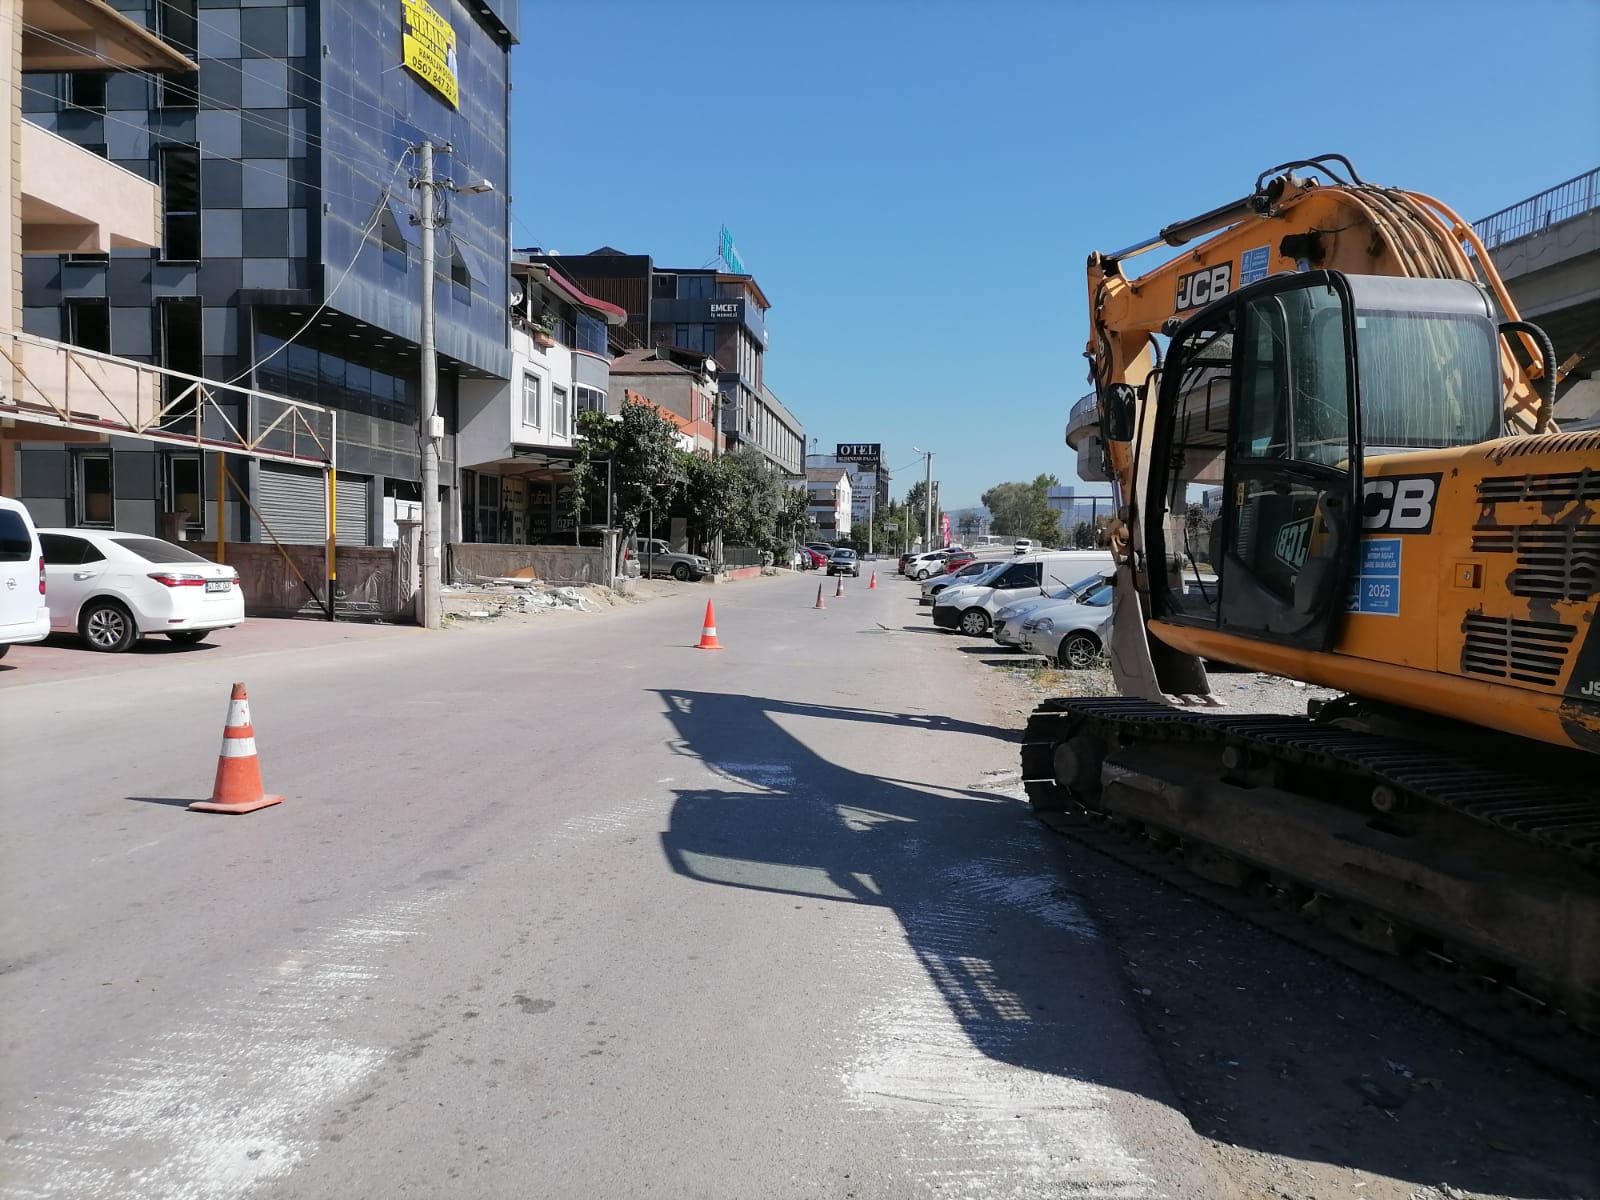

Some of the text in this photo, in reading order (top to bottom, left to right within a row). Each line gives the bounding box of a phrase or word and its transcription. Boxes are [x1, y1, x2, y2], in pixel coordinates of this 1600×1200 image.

[412, 56, 432, 76] 0507
[1177, 265, 1231, 309] JCB
[711, 304, 738, 312] EMCET
[841, 445, 876, 455] OTEL
[1361, 478, 1435, 529] CB
[1368, 584, 1391, 597] 2025
